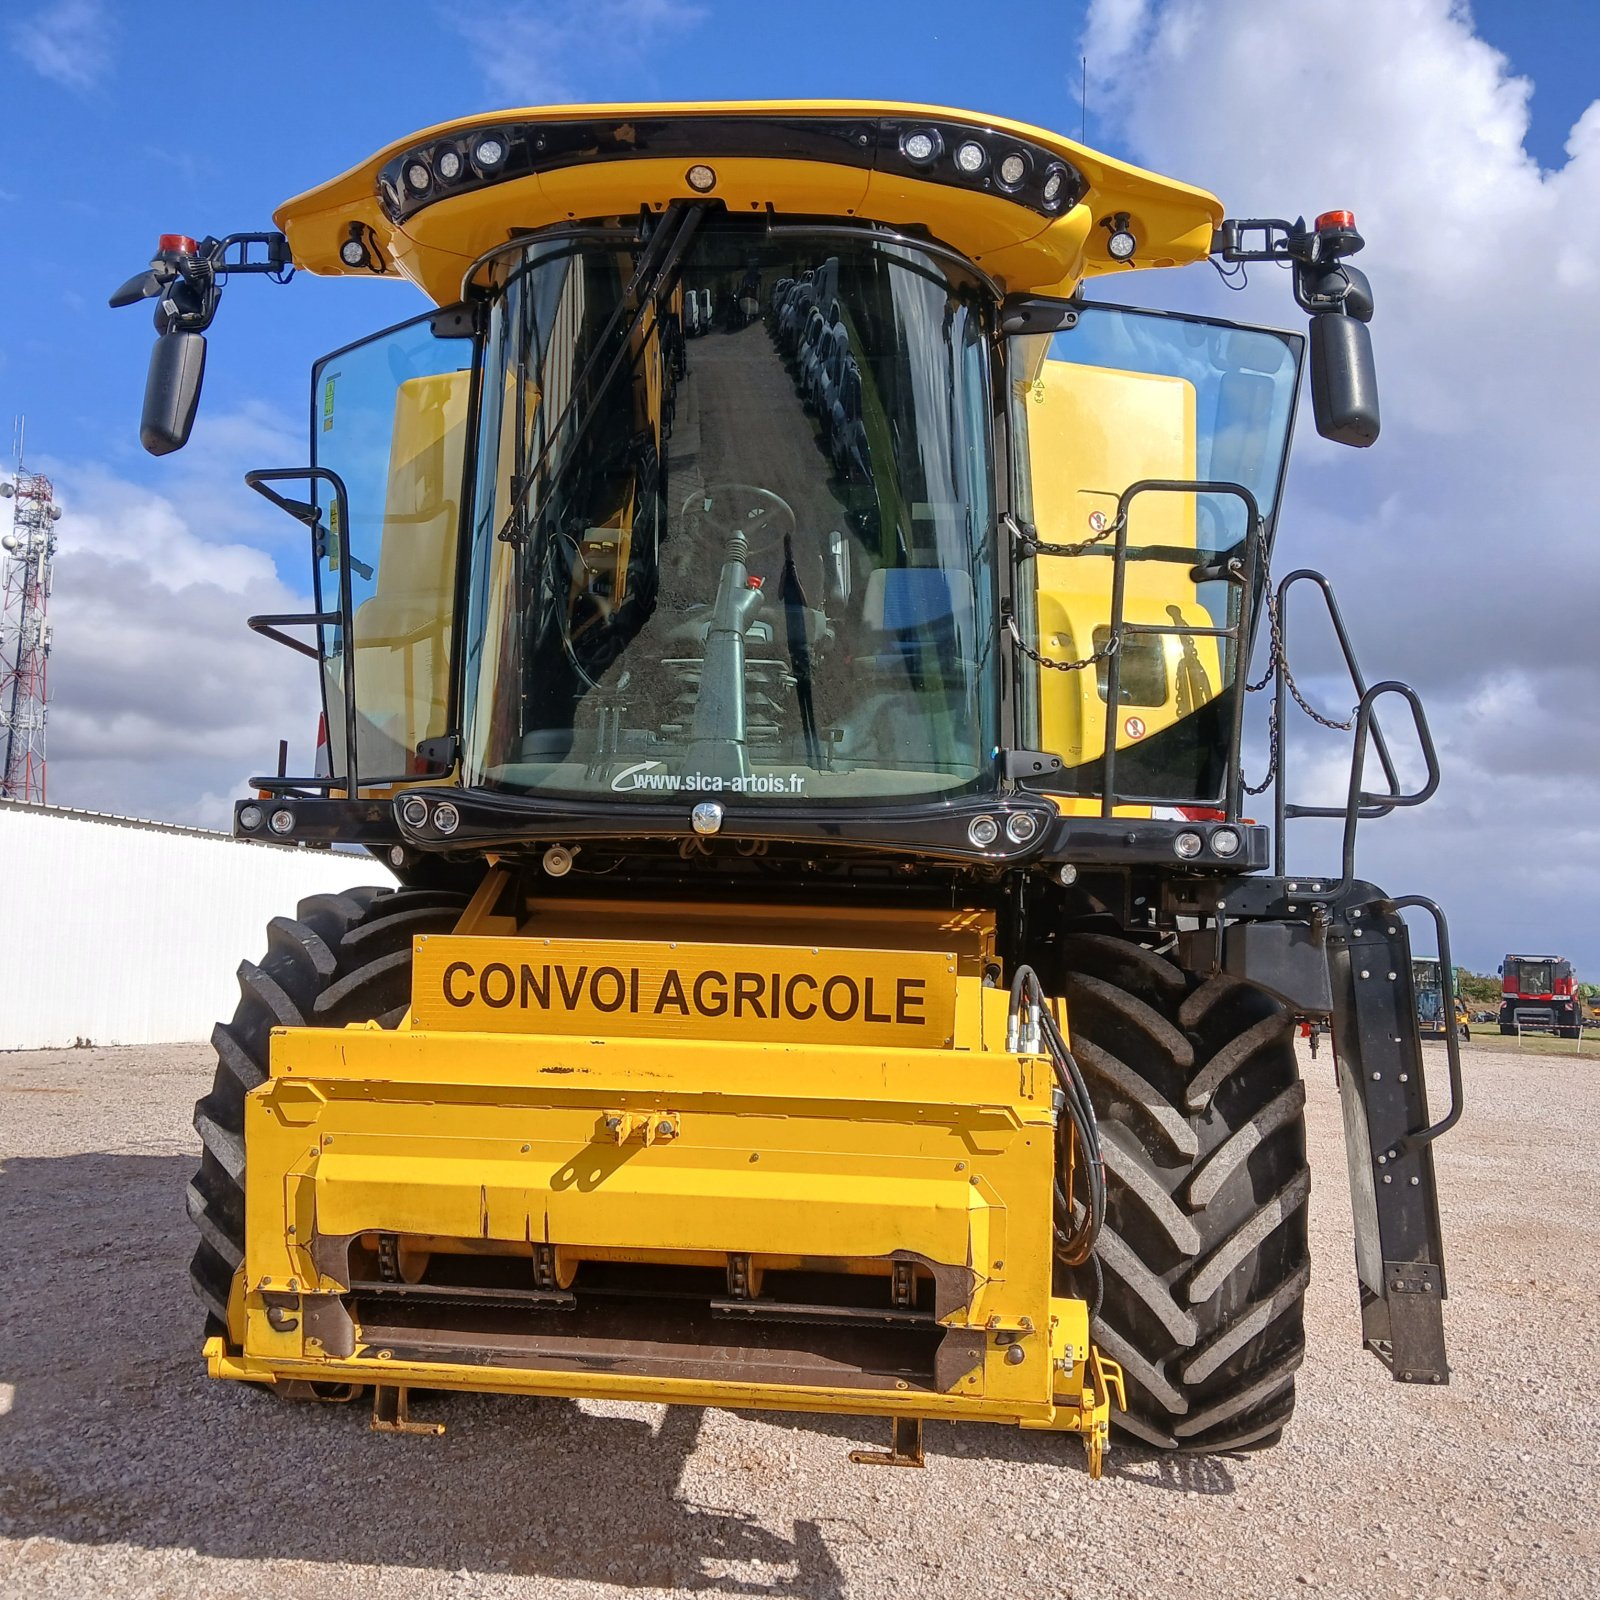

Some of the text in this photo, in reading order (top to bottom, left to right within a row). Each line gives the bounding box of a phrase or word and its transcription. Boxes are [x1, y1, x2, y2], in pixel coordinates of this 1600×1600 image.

[633, 771, 805, 793] www.sica-artois.fr
[442, 961, 927, 1025] CONVOI AGRICOLE
